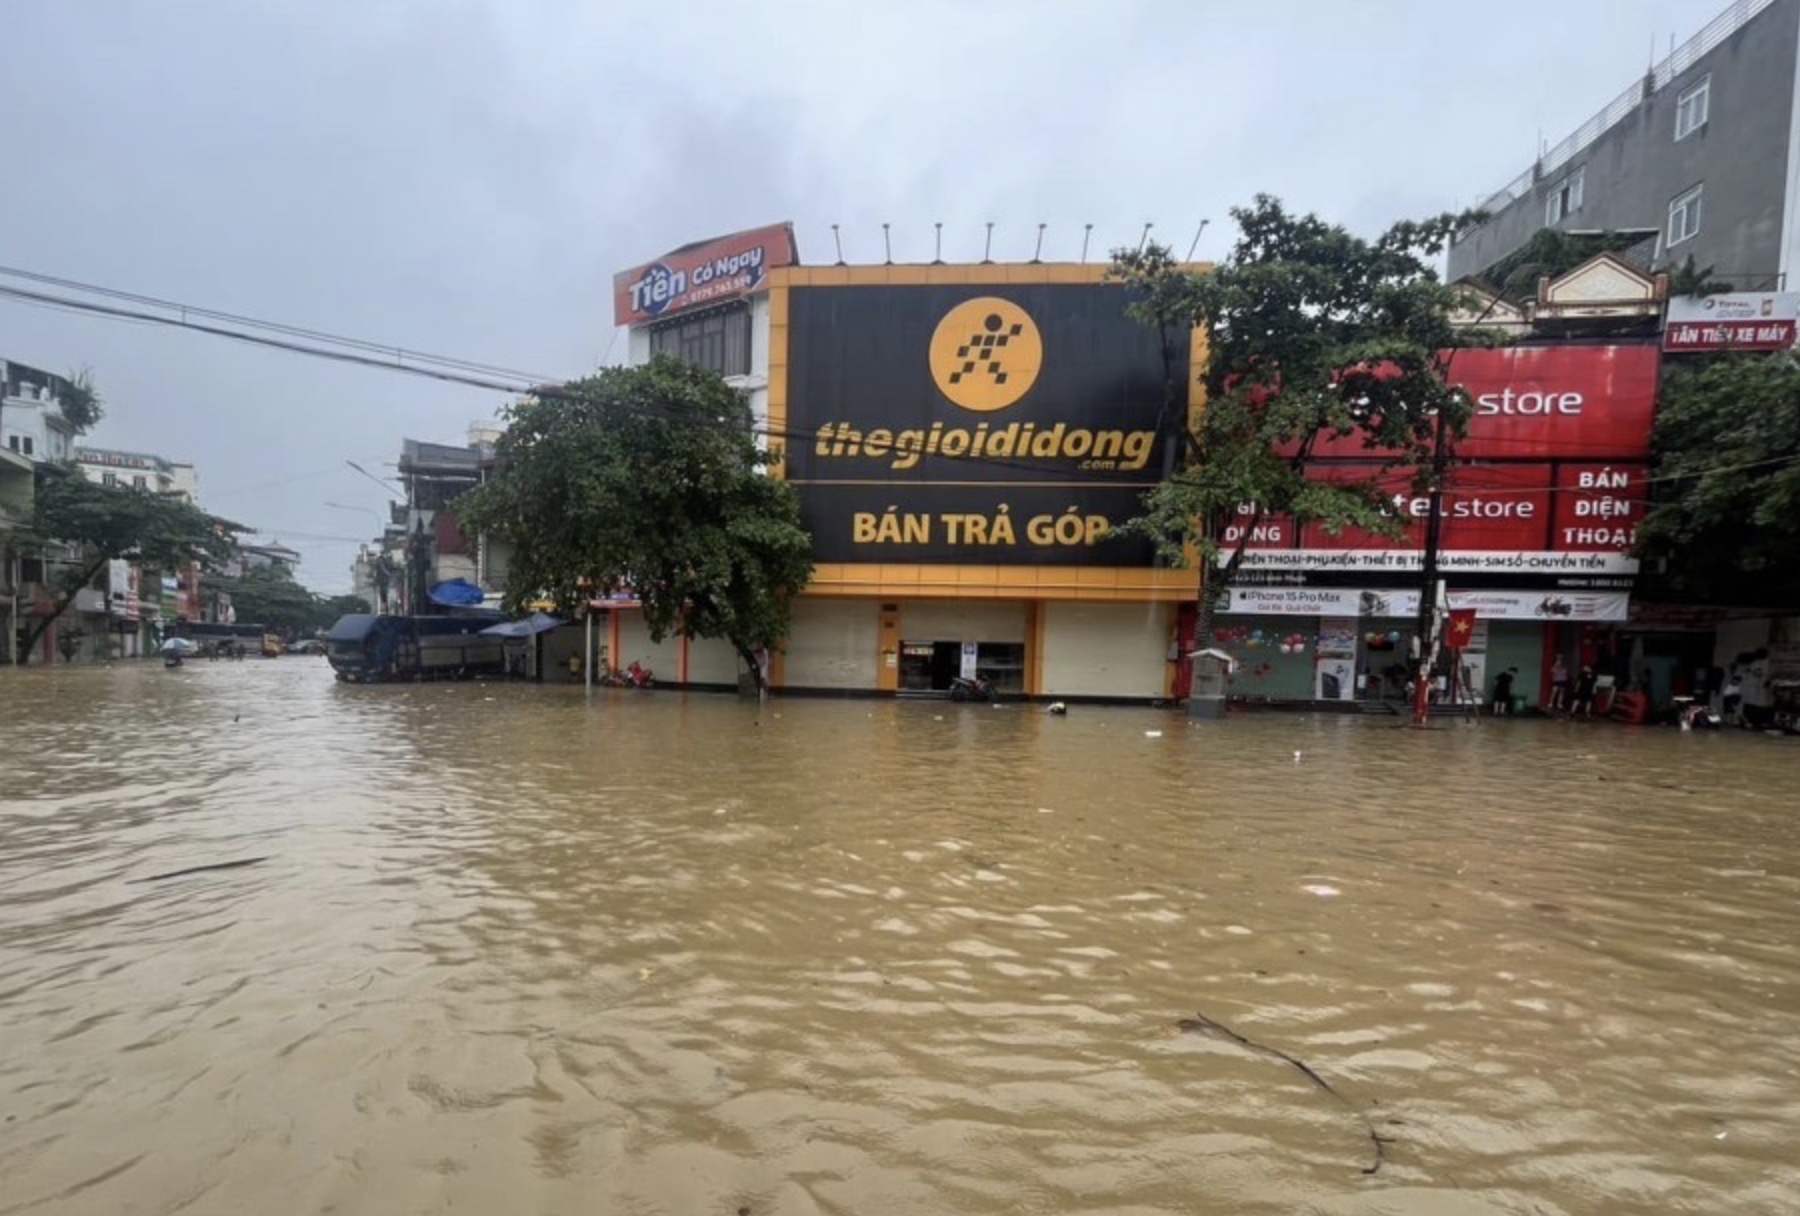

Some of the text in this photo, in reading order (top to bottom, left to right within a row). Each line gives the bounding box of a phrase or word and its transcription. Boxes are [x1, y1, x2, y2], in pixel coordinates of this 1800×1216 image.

[629, 246, 762, 311] Tiền Có Ngay
[1736, 328, 1755, 343] XE
[1756, 324, 1789, 342] MÁY
[1476, 387, 1583, 416] store
[814, 421, 1156, 471] thegioididong
[1578, 466, 1629, 488] BÁN
[1453, 497, 1535, 518] store
[1575, 495, 1631, 520] ĐIỆN
[852, 503, 1110, 546] BÁN TRẢ GÓP
[1247, 591, 1341, 603] iPhone 15 Pro Max
